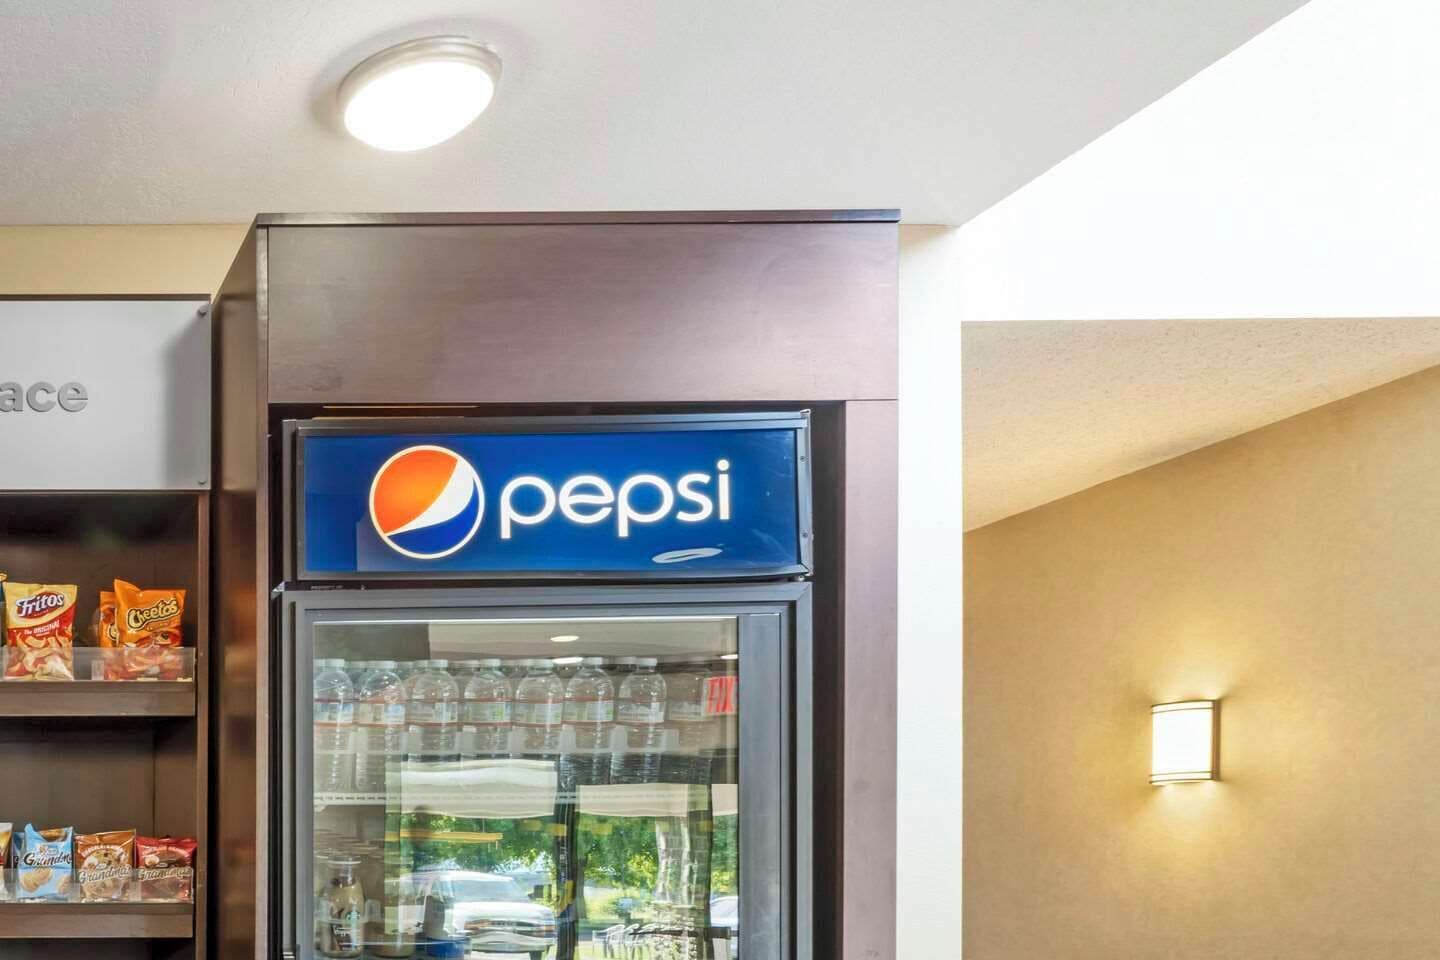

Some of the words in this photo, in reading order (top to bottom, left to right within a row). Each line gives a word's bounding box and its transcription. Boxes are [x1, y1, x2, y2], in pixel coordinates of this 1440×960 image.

[500, 459, 731, 539] pepsi
[16, 593, 64, 617] Fritos
[128, 600, 178, 628] Cheetos
